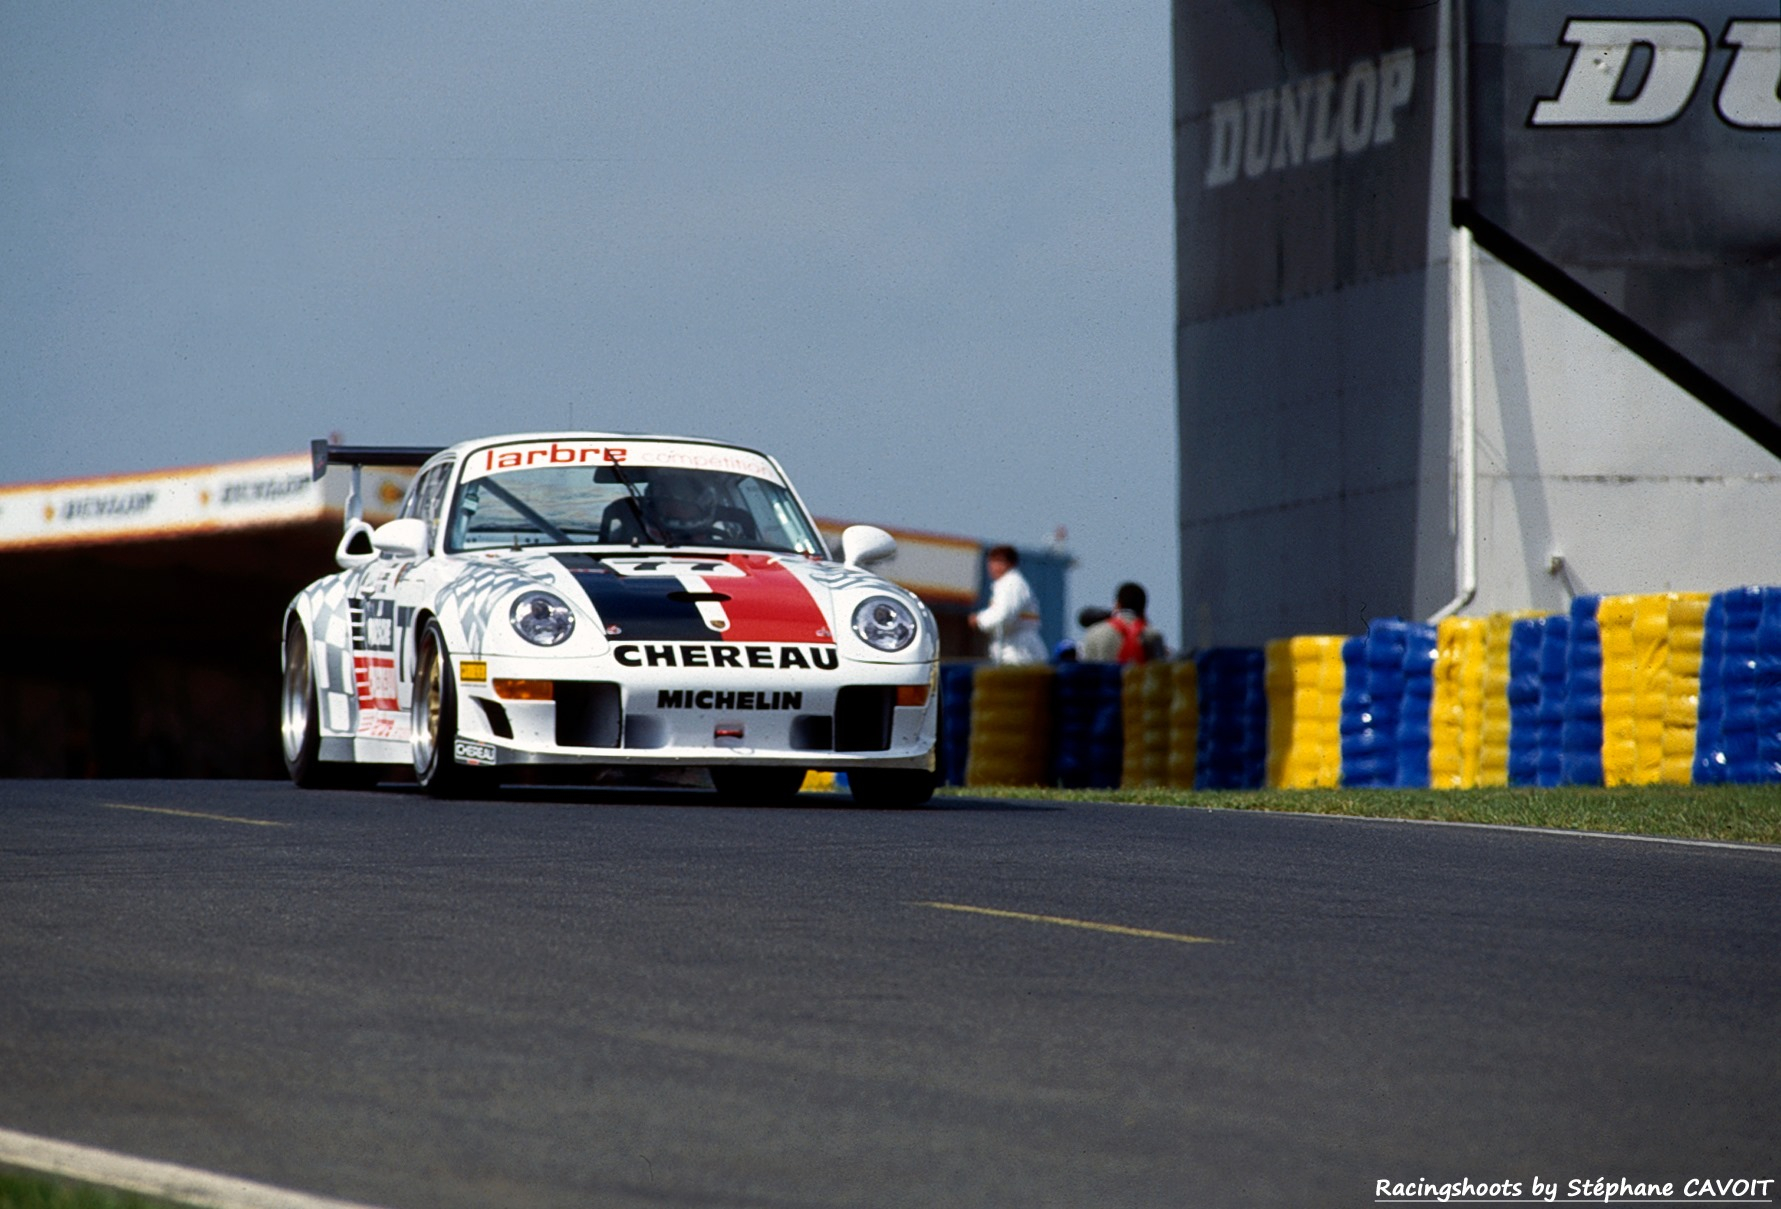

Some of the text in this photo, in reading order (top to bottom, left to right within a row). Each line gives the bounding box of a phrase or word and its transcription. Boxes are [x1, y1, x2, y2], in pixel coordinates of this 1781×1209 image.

[1205, 47, 1416, 189] DUNLOP
[486, 443, 627, 471] larbre
[614, 644, 839, 670] CHEREAU
[657, 690, 803, 710] MICHELIN
